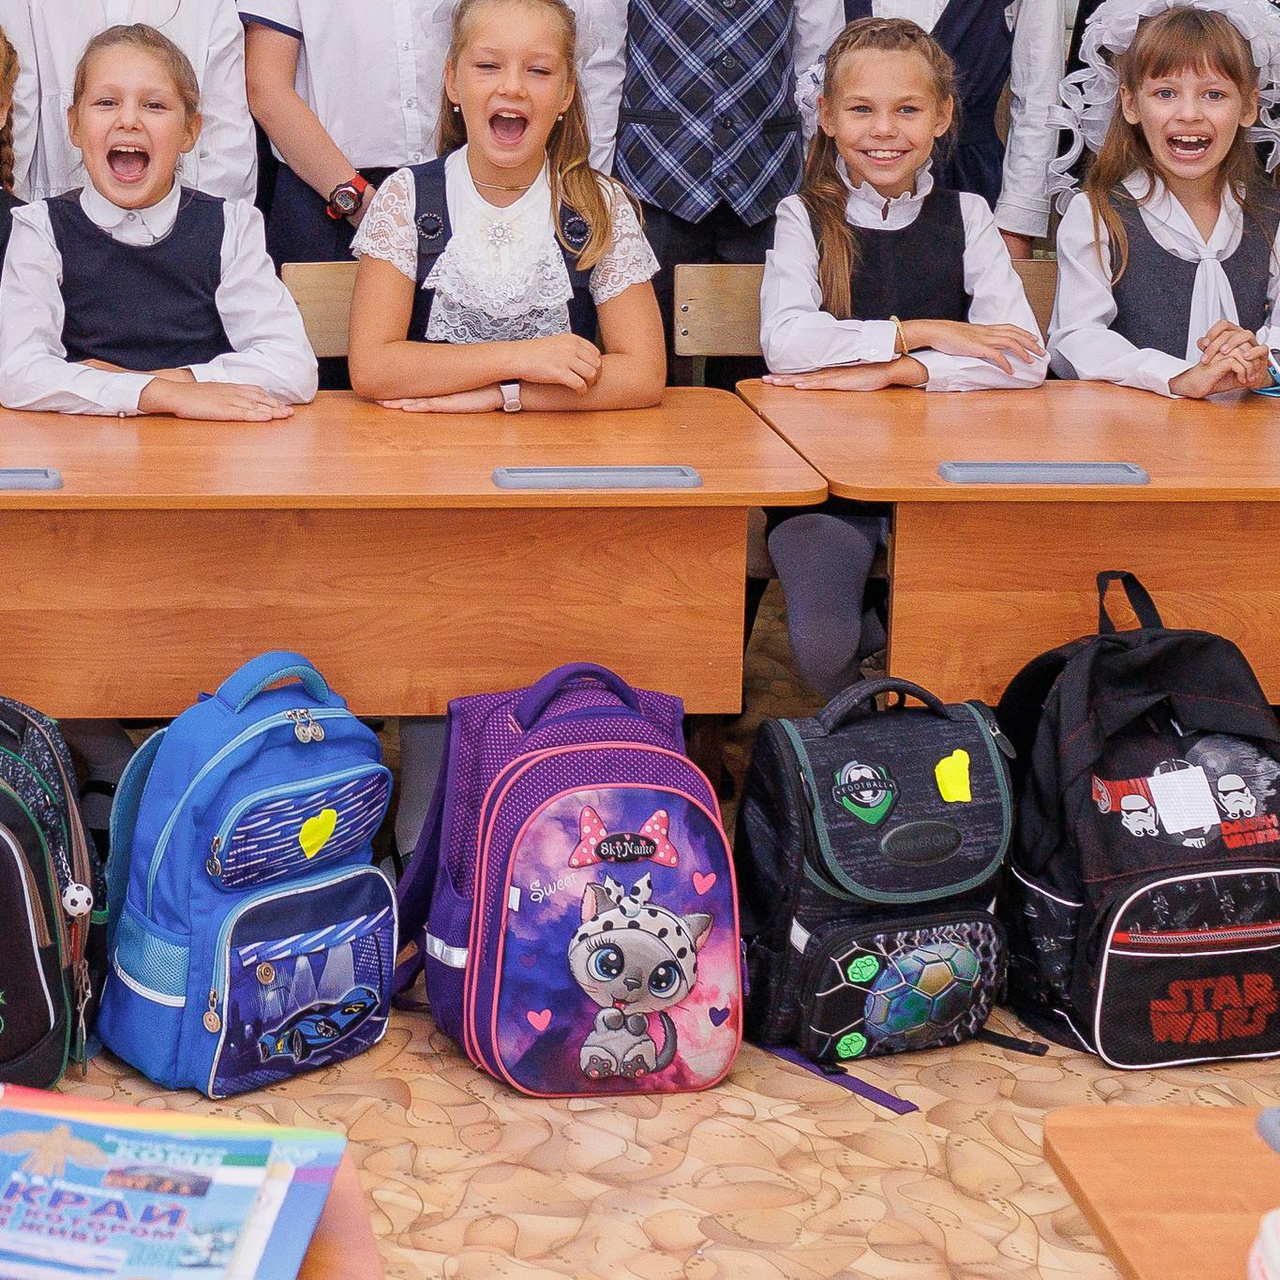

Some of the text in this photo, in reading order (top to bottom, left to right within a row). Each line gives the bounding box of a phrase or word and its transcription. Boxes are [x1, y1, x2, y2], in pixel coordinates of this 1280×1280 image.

[841, 780, 889, 794] FOOTBALL
[1150, 973, 1276, 1012] STAR
[1150, 1008, 1278, 1044] WARS
